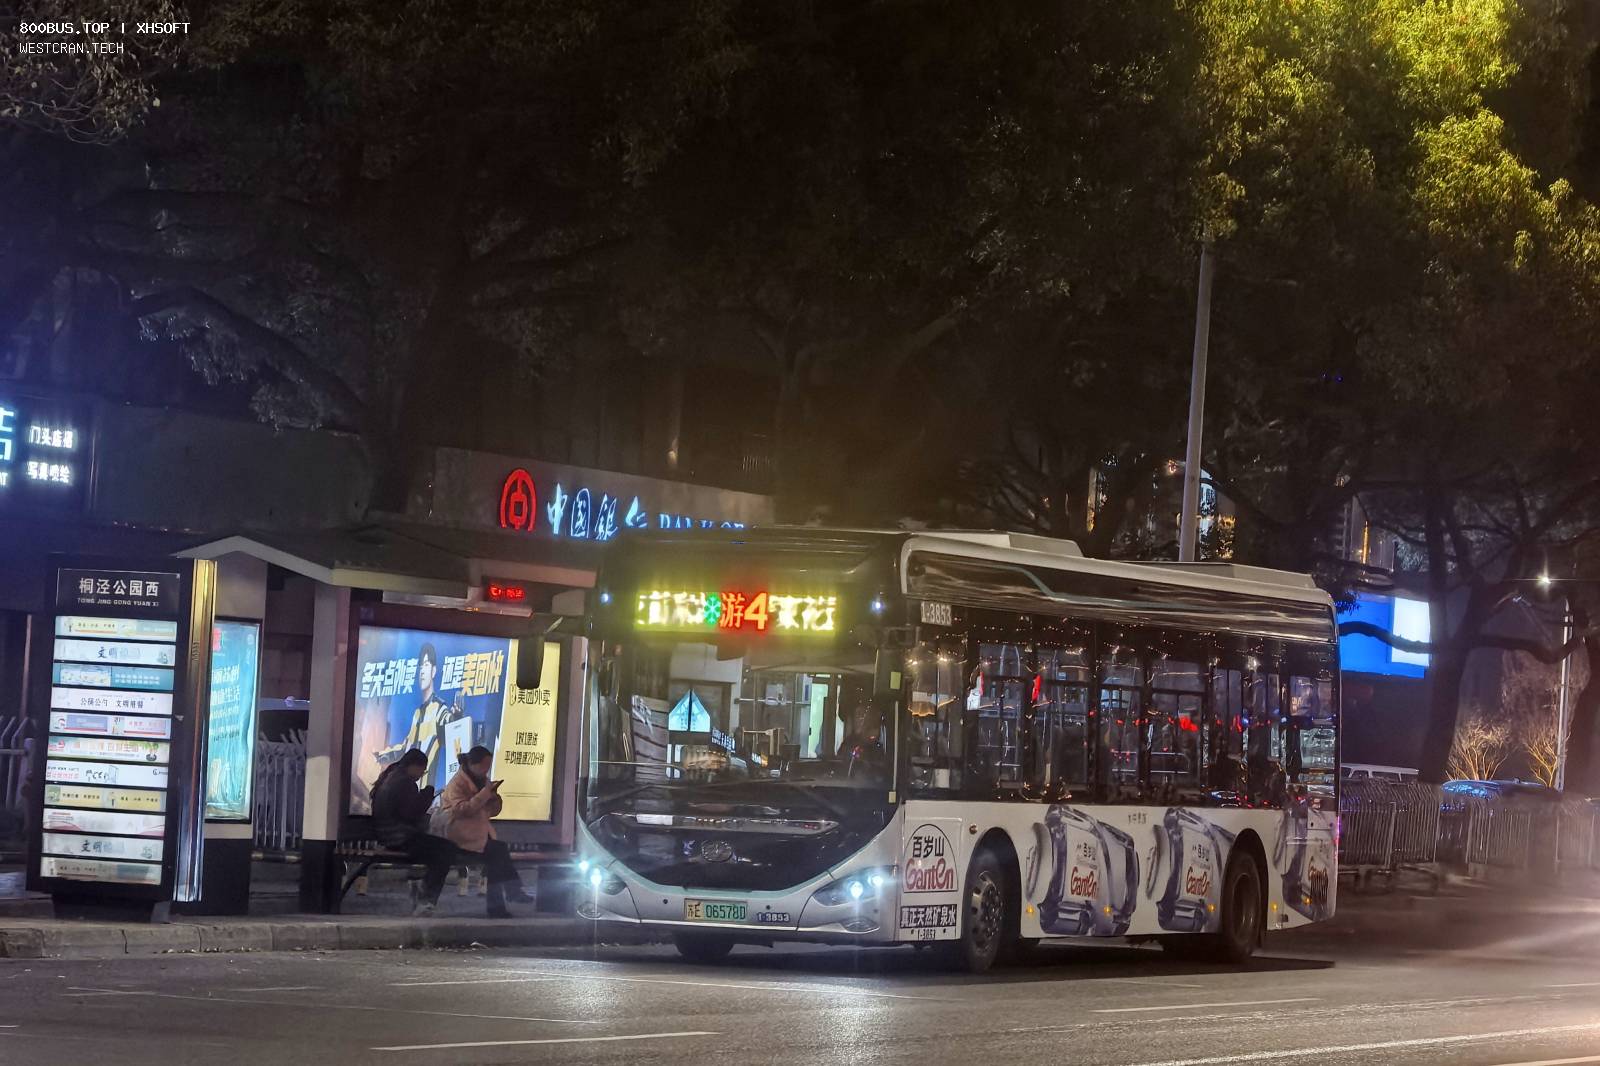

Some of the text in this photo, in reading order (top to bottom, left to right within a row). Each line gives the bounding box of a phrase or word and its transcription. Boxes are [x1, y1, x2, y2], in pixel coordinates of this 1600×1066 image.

[79, 578, 160, 597] 桐泾公园西
[719, 592, 768, 630] 游4
[360, 658, 419, 698] 冬天点外卖
[440, 650, 504, 697] 还是美团快
[518, 688, 550, 706] 美团外卖
[912, 835, 944, 858] 百岁山
[905, 858, 954, 889] Ganten
[900, 905, 957, 928] 真正天然矿泉水
